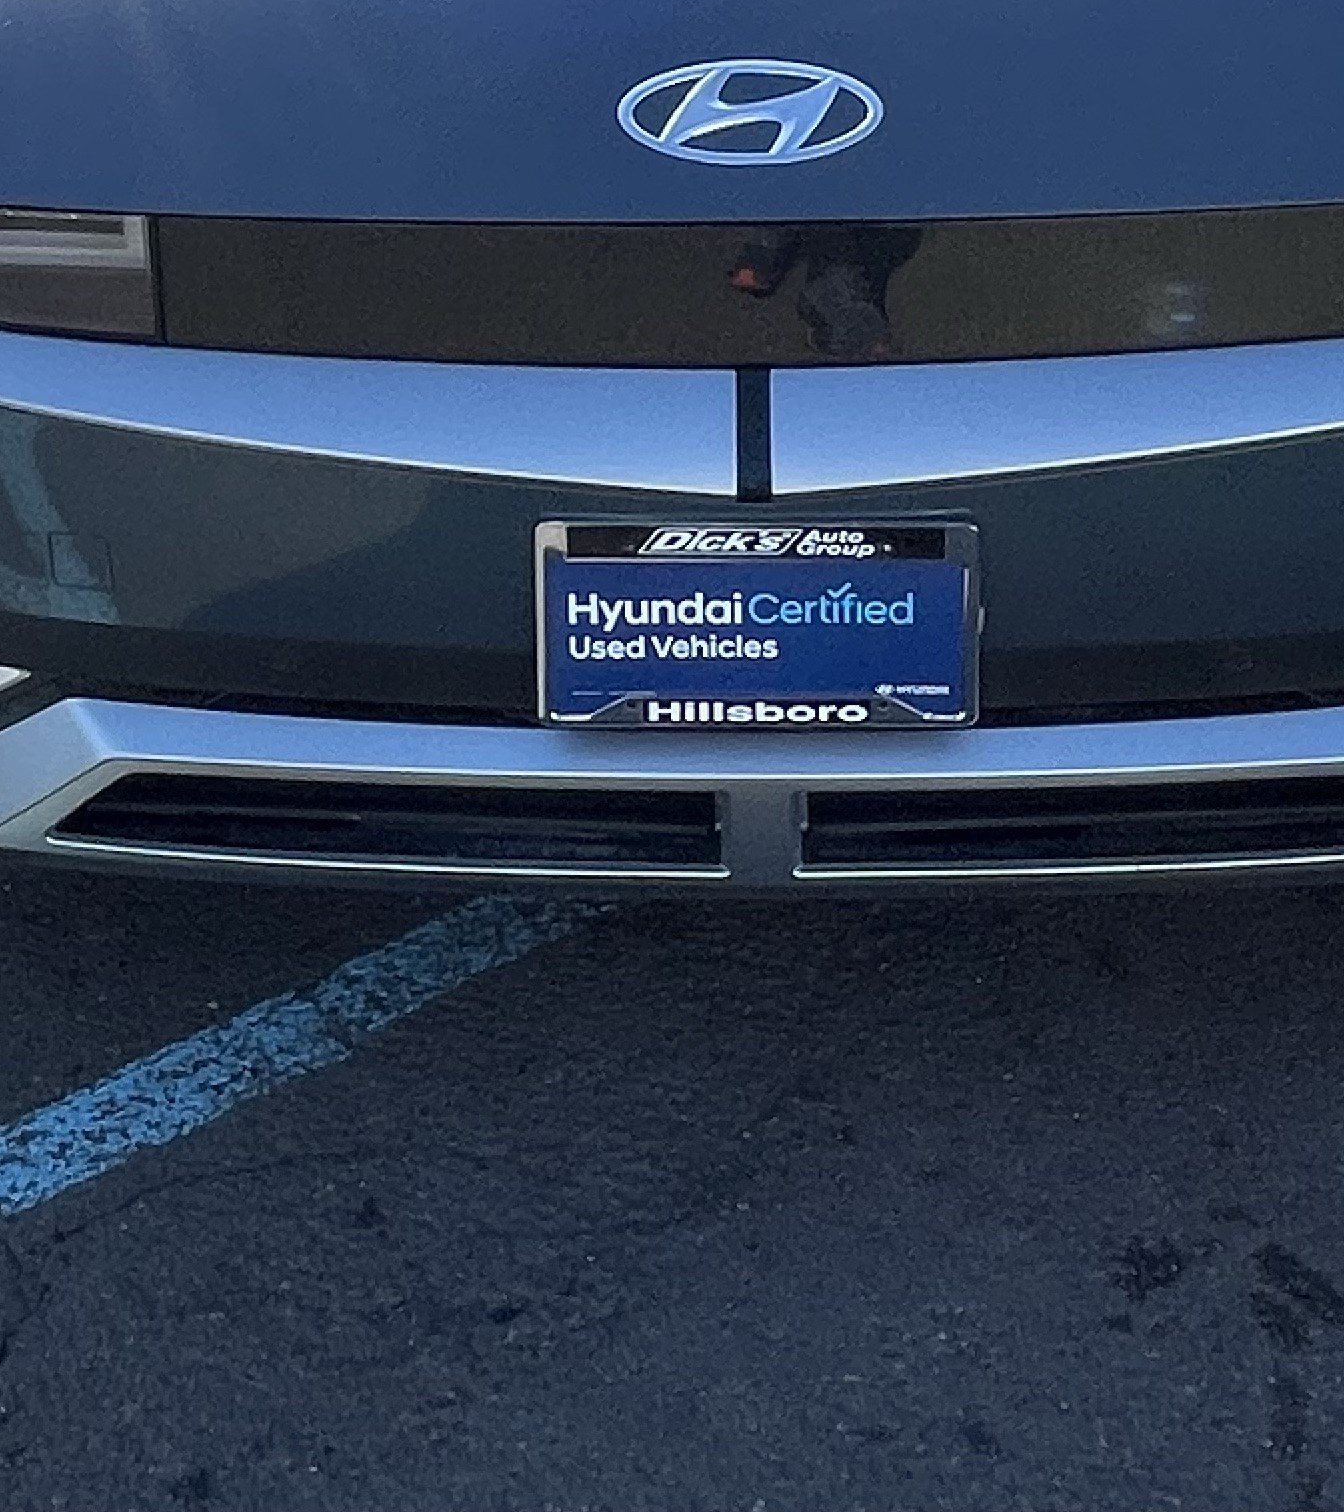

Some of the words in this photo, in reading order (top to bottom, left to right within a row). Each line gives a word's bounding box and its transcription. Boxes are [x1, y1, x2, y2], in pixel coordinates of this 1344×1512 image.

[806, 529, 864, 544] Auto
[796, 542, 876, 558] Group
[568, 592, 743, 631] Hyundai
[748, 584, 914, 624] Certified
[568, 635, 645, 659] Used
[651, 634, 779, 659] Vehicles
[647, 702, 869, 723] Hillsboro
